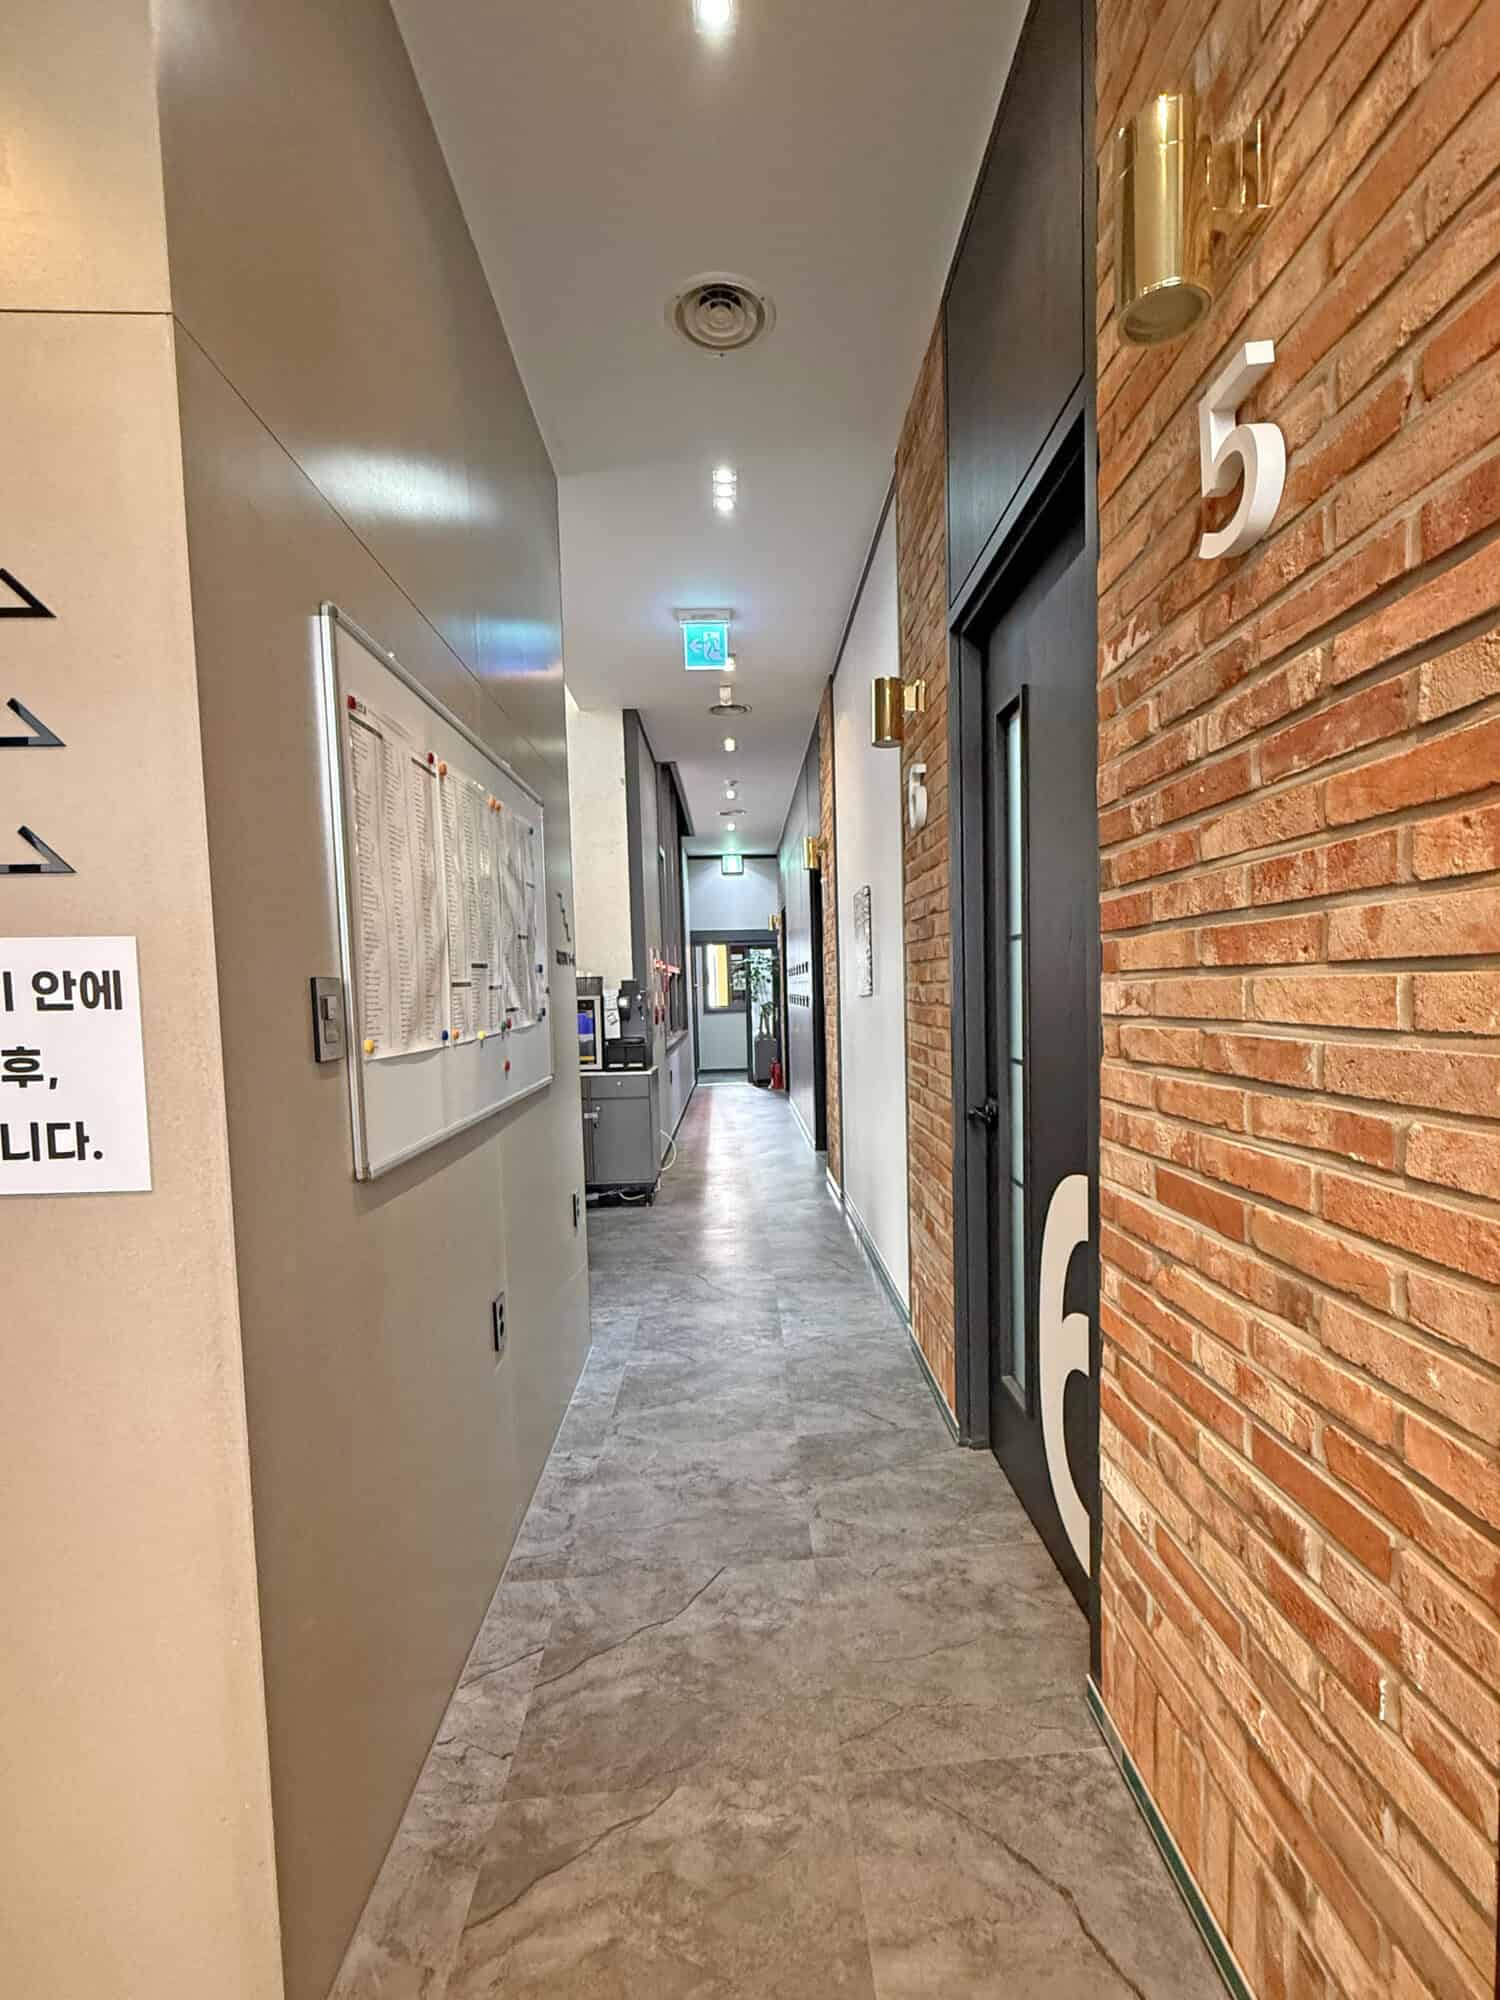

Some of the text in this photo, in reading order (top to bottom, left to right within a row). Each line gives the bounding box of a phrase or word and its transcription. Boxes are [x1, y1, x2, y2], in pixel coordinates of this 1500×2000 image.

[1198, 340, 1287, 560] 5
[32, 969, 123, 1012] 안에
[0, 1045, 58, 1090] 후,
